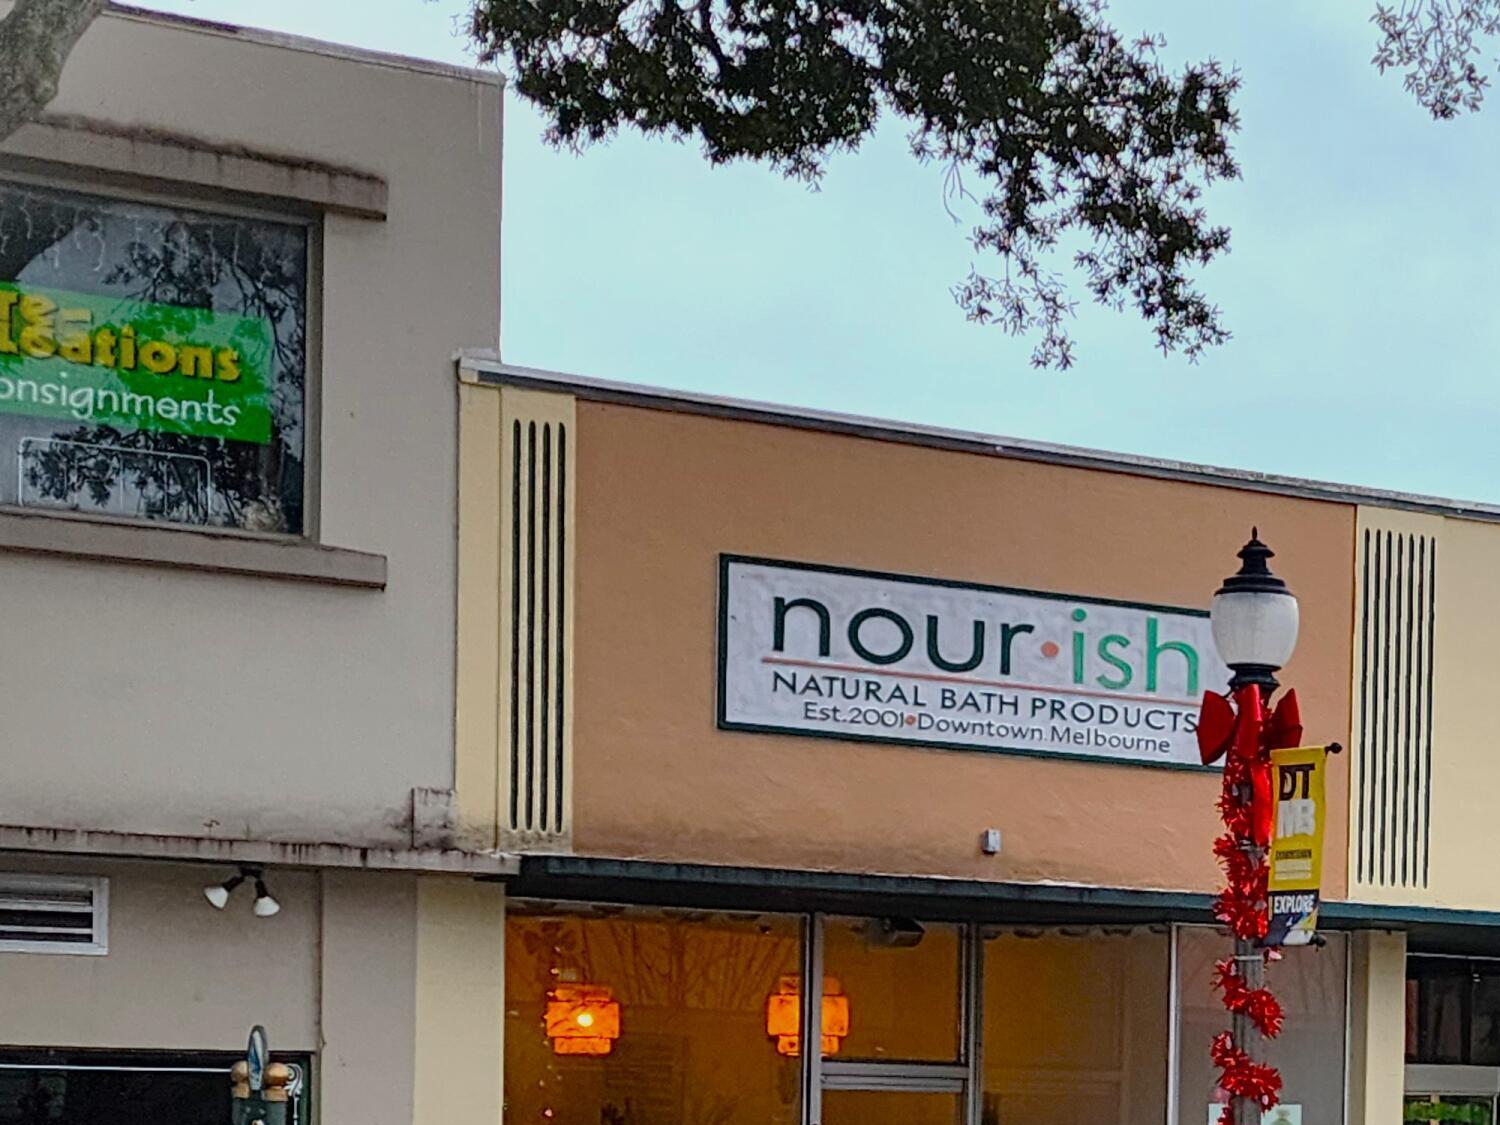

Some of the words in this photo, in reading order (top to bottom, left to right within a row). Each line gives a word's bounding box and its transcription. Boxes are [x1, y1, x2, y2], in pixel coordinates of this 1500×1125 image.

[772, 671, 927, 707] NATURAL
[941, 688, 1019, 716] BATH
[1031, 697, 1198, 734] PRODUCTS
[1051, 725, 1170, 753] Melbourne
[1278, 764, 1315, 800] DT
[1274, 894, 1315, 914] EXPLORE
